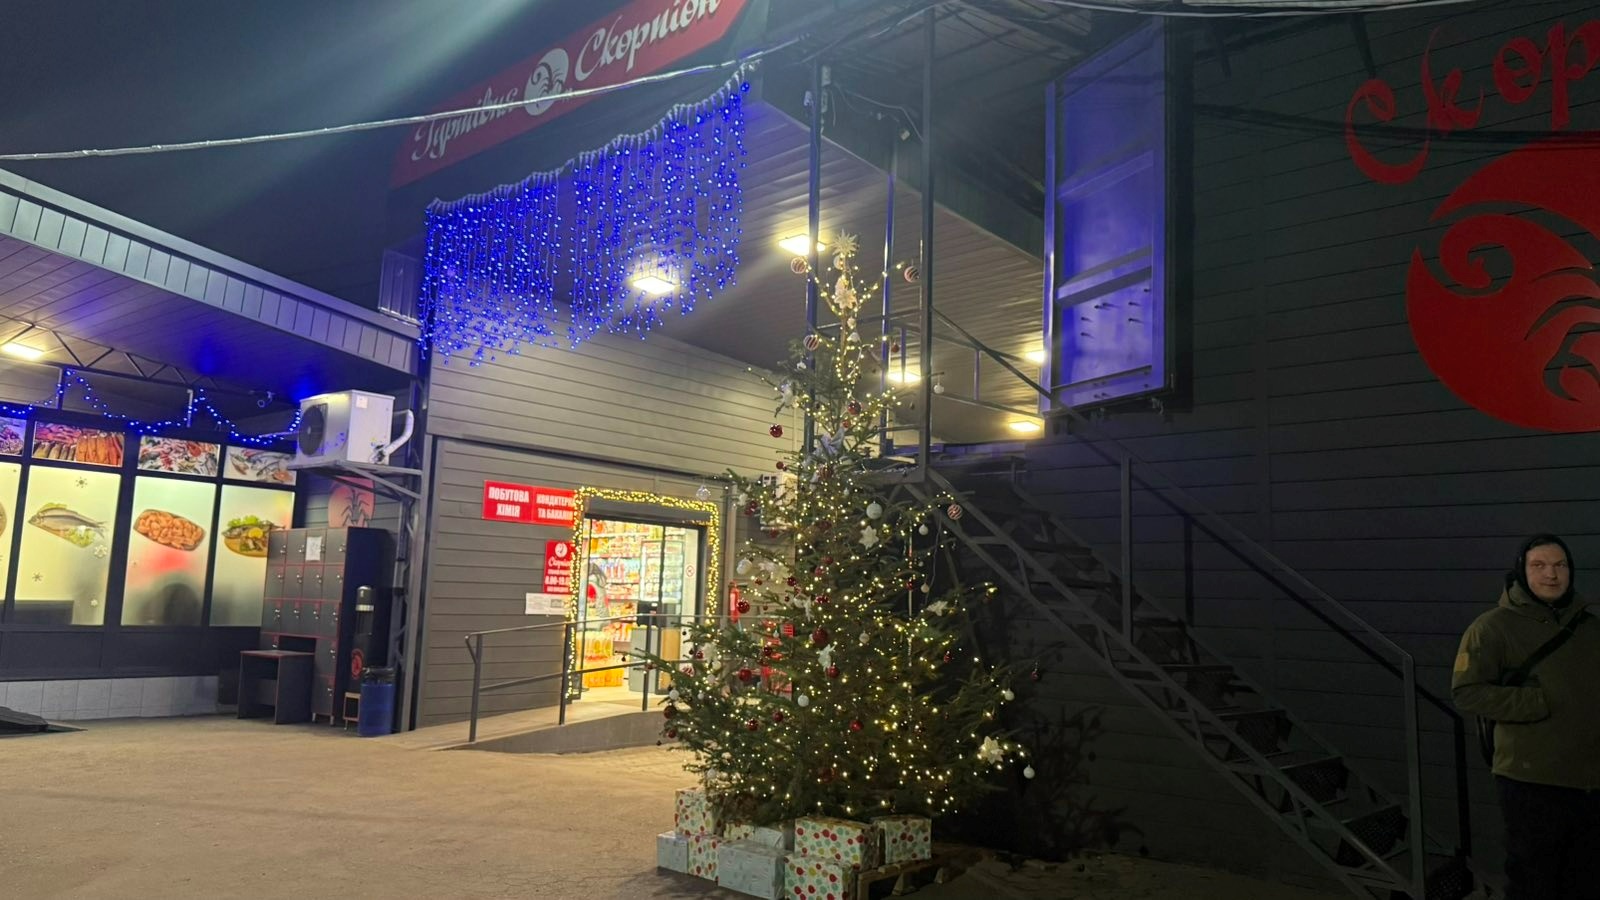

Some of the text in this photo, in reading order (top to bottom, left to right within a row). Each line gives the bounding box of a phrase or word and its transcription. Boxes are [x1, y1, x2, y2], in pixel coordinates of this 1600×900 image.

[574, 0, 719, 81] Скорпіон
[488, 486, 530, 503] ПОБУТОВА
[496, 503, 520, 518] ХІМІЯ
[538, 508, 547, 518] ТА
